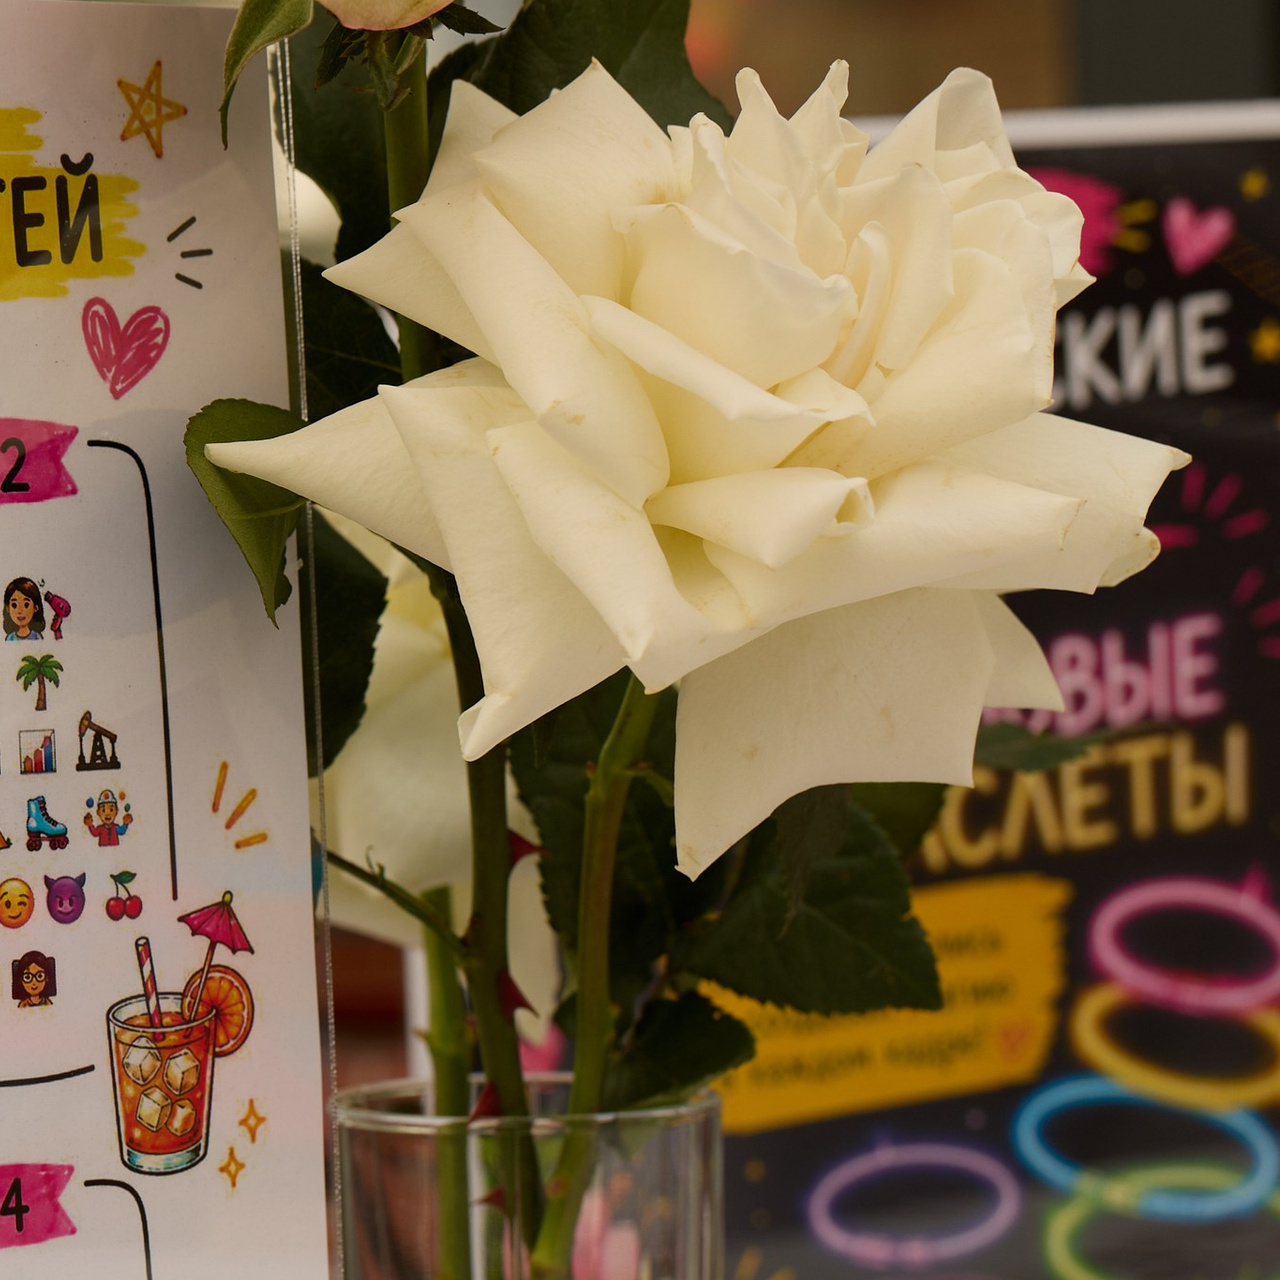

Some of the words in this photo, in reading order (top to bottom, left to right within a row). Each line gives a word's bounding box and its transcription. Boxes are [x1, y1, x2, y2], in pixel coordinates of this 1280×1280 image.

[1054, 288, 1234, 411] КИЕ
[0, 437, 31, 494] 2
[0, 1177, 30, 1233] 4
